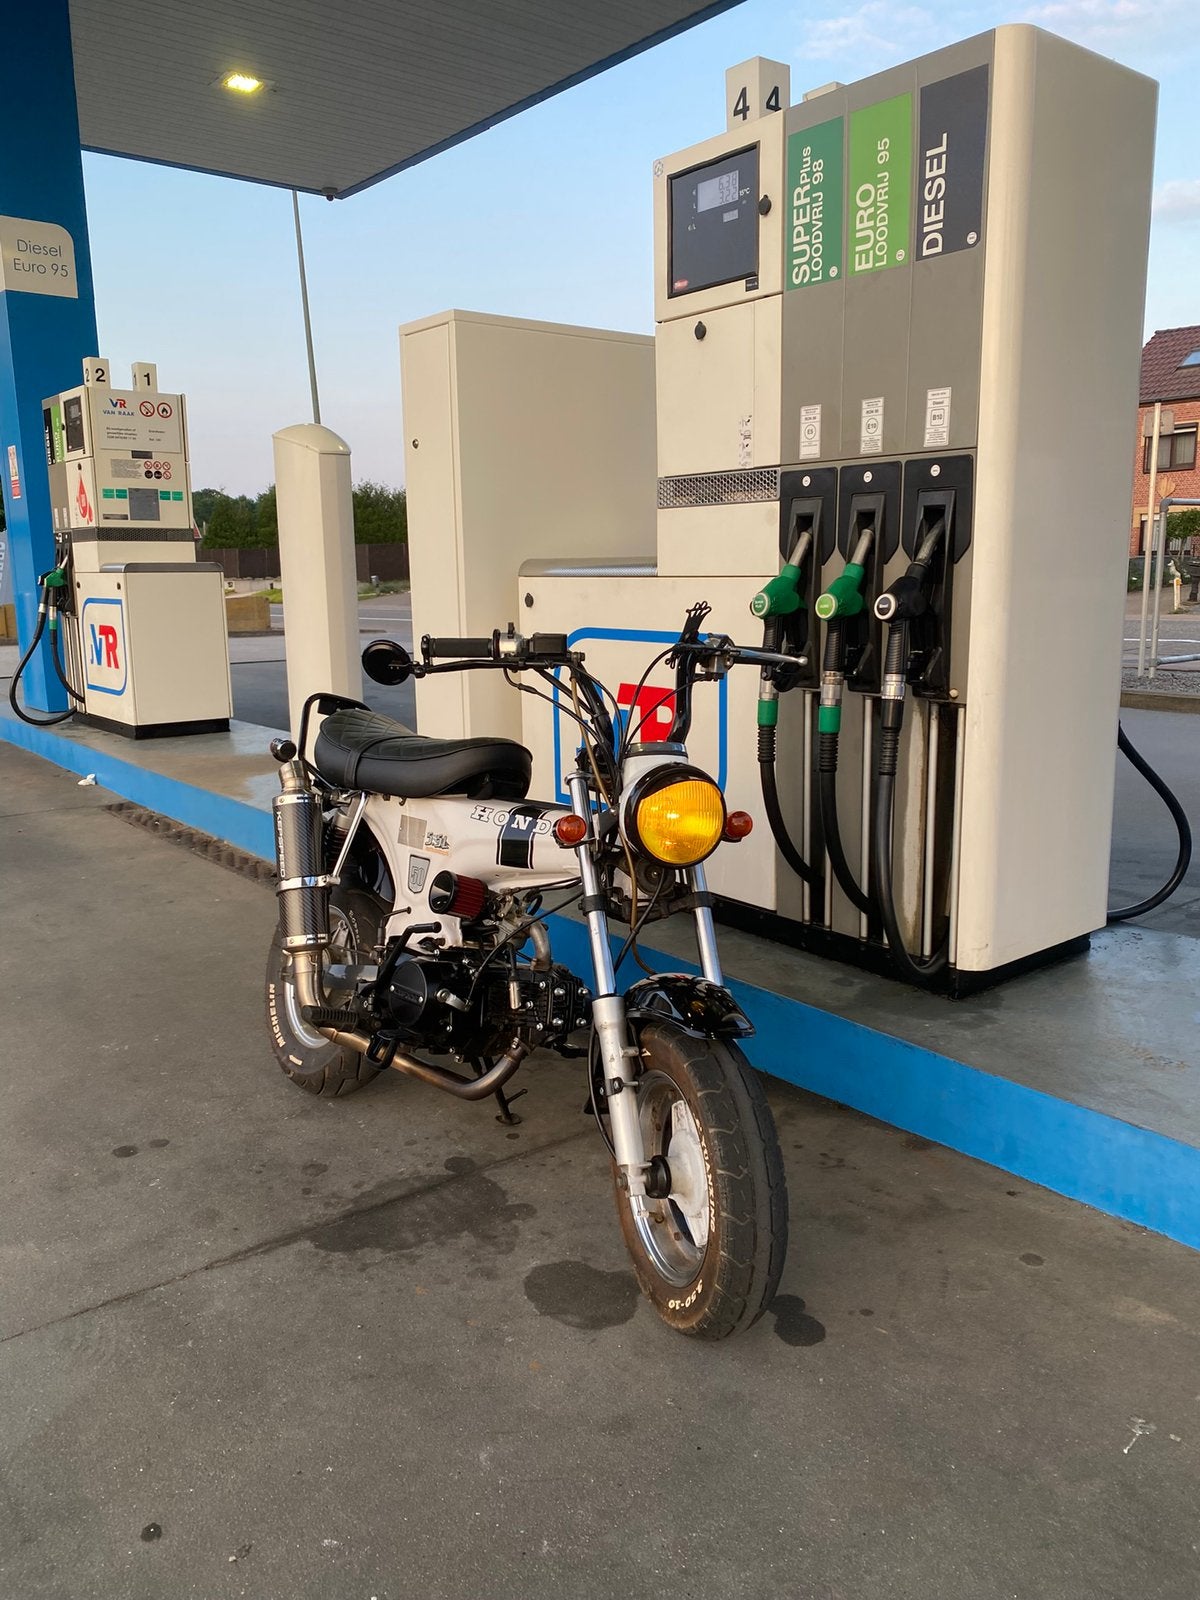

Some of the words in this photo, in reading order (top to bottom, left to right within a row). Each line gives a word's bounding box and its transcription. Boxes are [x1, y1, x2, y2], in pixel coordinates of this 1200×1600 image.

[733, 86, 750, 121] 4
[765, 85, 782, 112] 4
[877, 137, 890, 165] 95
[812, 158, 824, 185] 98
[922, 132, 948, 257] DIESEL
[854, 183, 876, 272] EURO
[875, 171, 889, 267] LOODVRIJ
[17, 239, 62, 257] Diesel
[811, 191, 824, 282] LOODVRIJ
[13, 258, 47, 274] Euro
[51, 263, 68, 277] 95
[95, 368, 106, 382] 2
[144, 372, 151, 386] 1
[109, 398, 127, 409] VR
[90, 623, 119, 669] VR
[470, 805, 553, 838] HOND
[410, 865, 425, 887] 50
[269, 983, 287, 1048] MICHELIN
